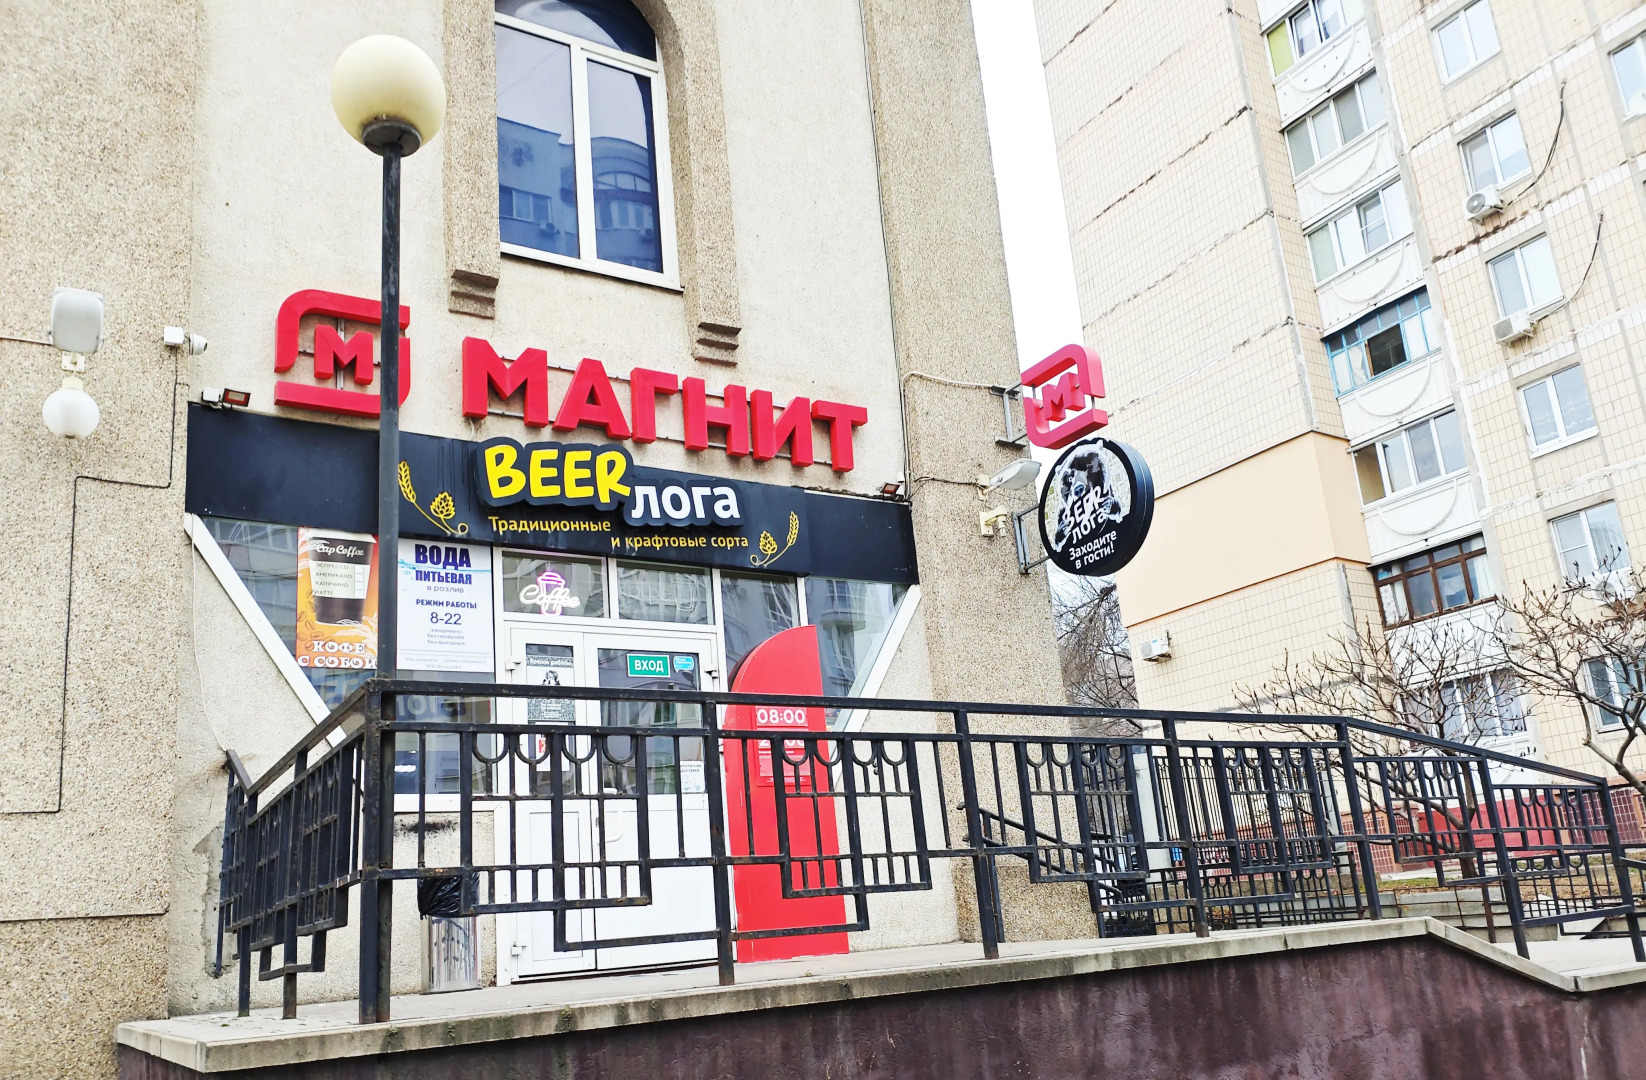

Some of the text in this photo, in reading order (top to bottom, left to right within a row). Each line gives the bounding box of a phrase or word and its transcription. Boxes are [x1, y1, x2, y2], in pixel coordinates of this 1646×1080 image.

[462, 336, 868, 473] МАГНИТ
[484, 444, 631, 503] BEER
[631, 485, 741, 519] лога
[488, 516, 611, 535] Традиционные
[1071, 507, 1107, 544] лога
[336, 545, 365, 558] Coffee
[610, 534, 749, 553] и крафтовые сорта
[1068, 530, 1117, 560] Заходите
[415, 544, 472, 571] ВОДА
[1075, 541, 1115, 569] в гости!
[415, 570, 473, 585] ПИТЬЕВАЯ
[416, 599, 477, 609] РЕЖИМ РАБОТЫ
[430, 612, 462, 626] 8-22
[312, 640, 365, 654] КОФЕ
[297, 655, 310, 667] С
[634, 659, 664, 673] ВХОД
[757, 709, 806, 724] 08:00
